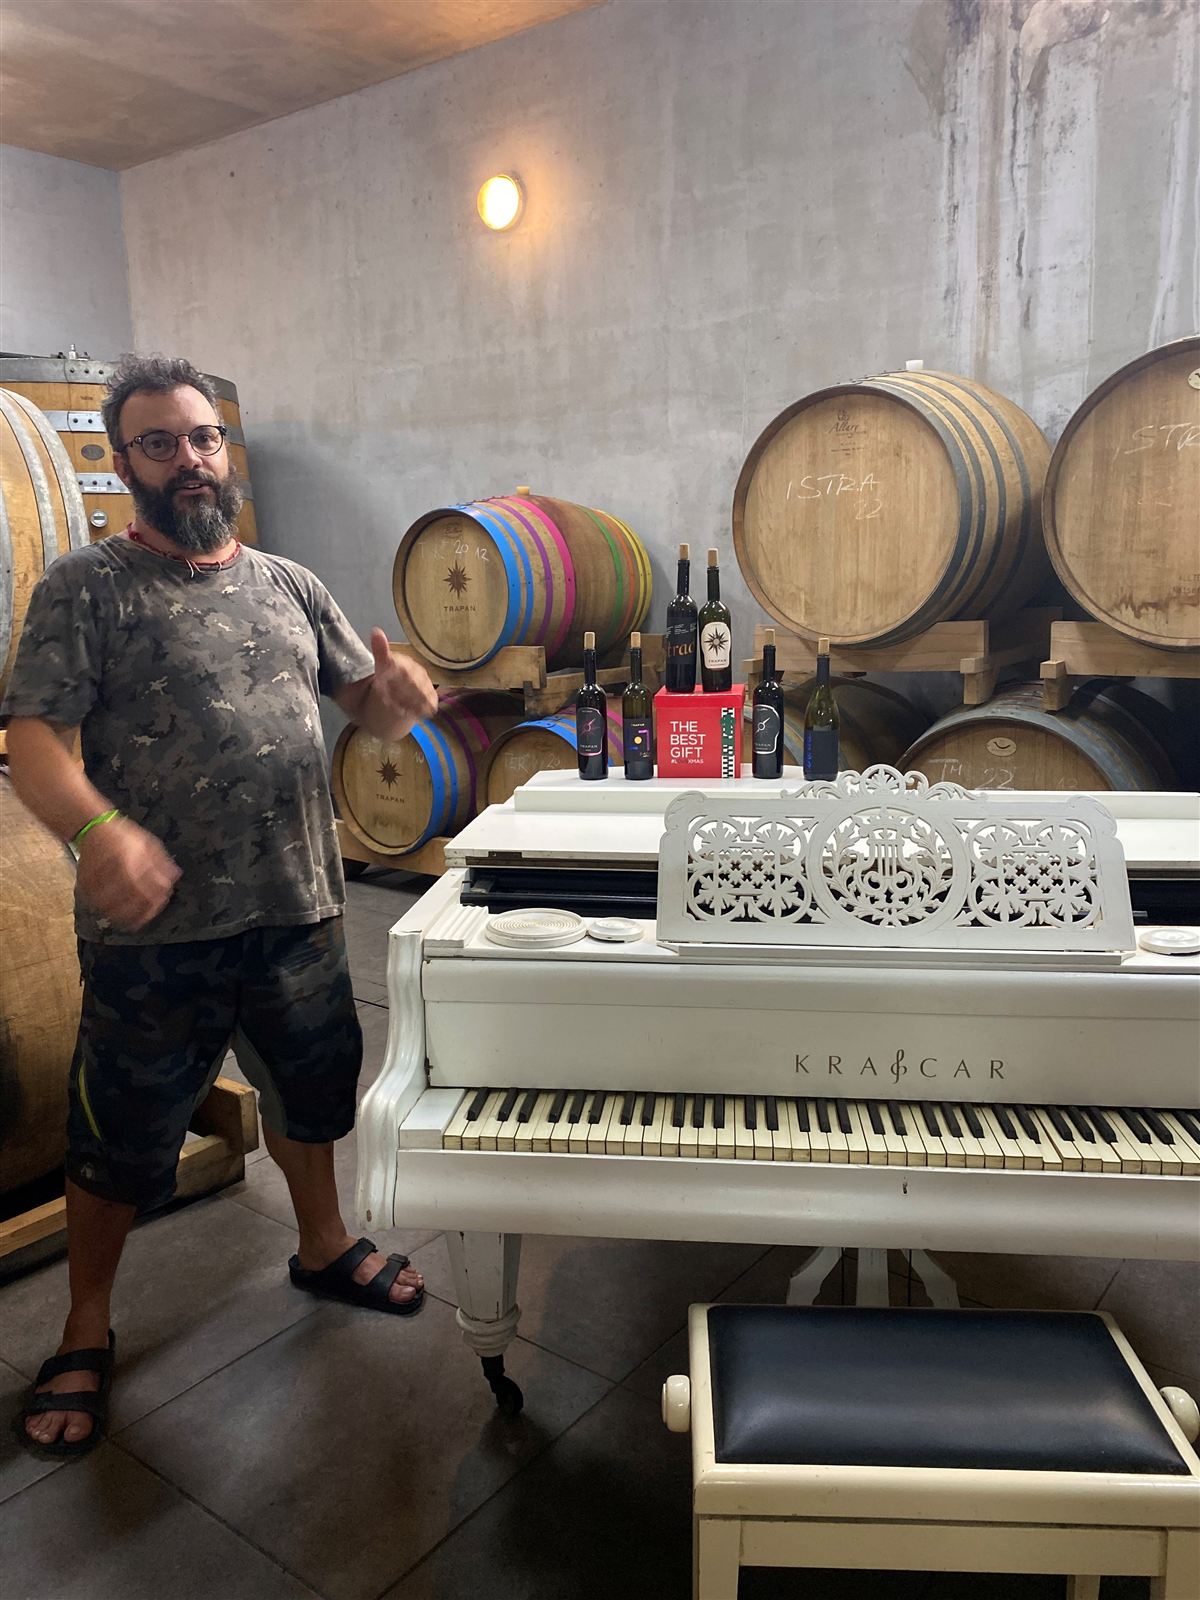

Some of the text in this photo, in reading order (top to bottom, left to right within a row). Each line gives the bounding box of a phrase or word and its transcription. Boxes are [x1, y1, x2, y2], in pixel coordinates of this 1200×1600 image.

[453, 539, 469, 554] 20
[475, 546, 490, 562] 12
[670, 720, 698, 732] THE
[670, 733, 706, 746] BEST
[670, 746, 703, 758] GIFT
[375, 793, 405, 804] TRAPAN
